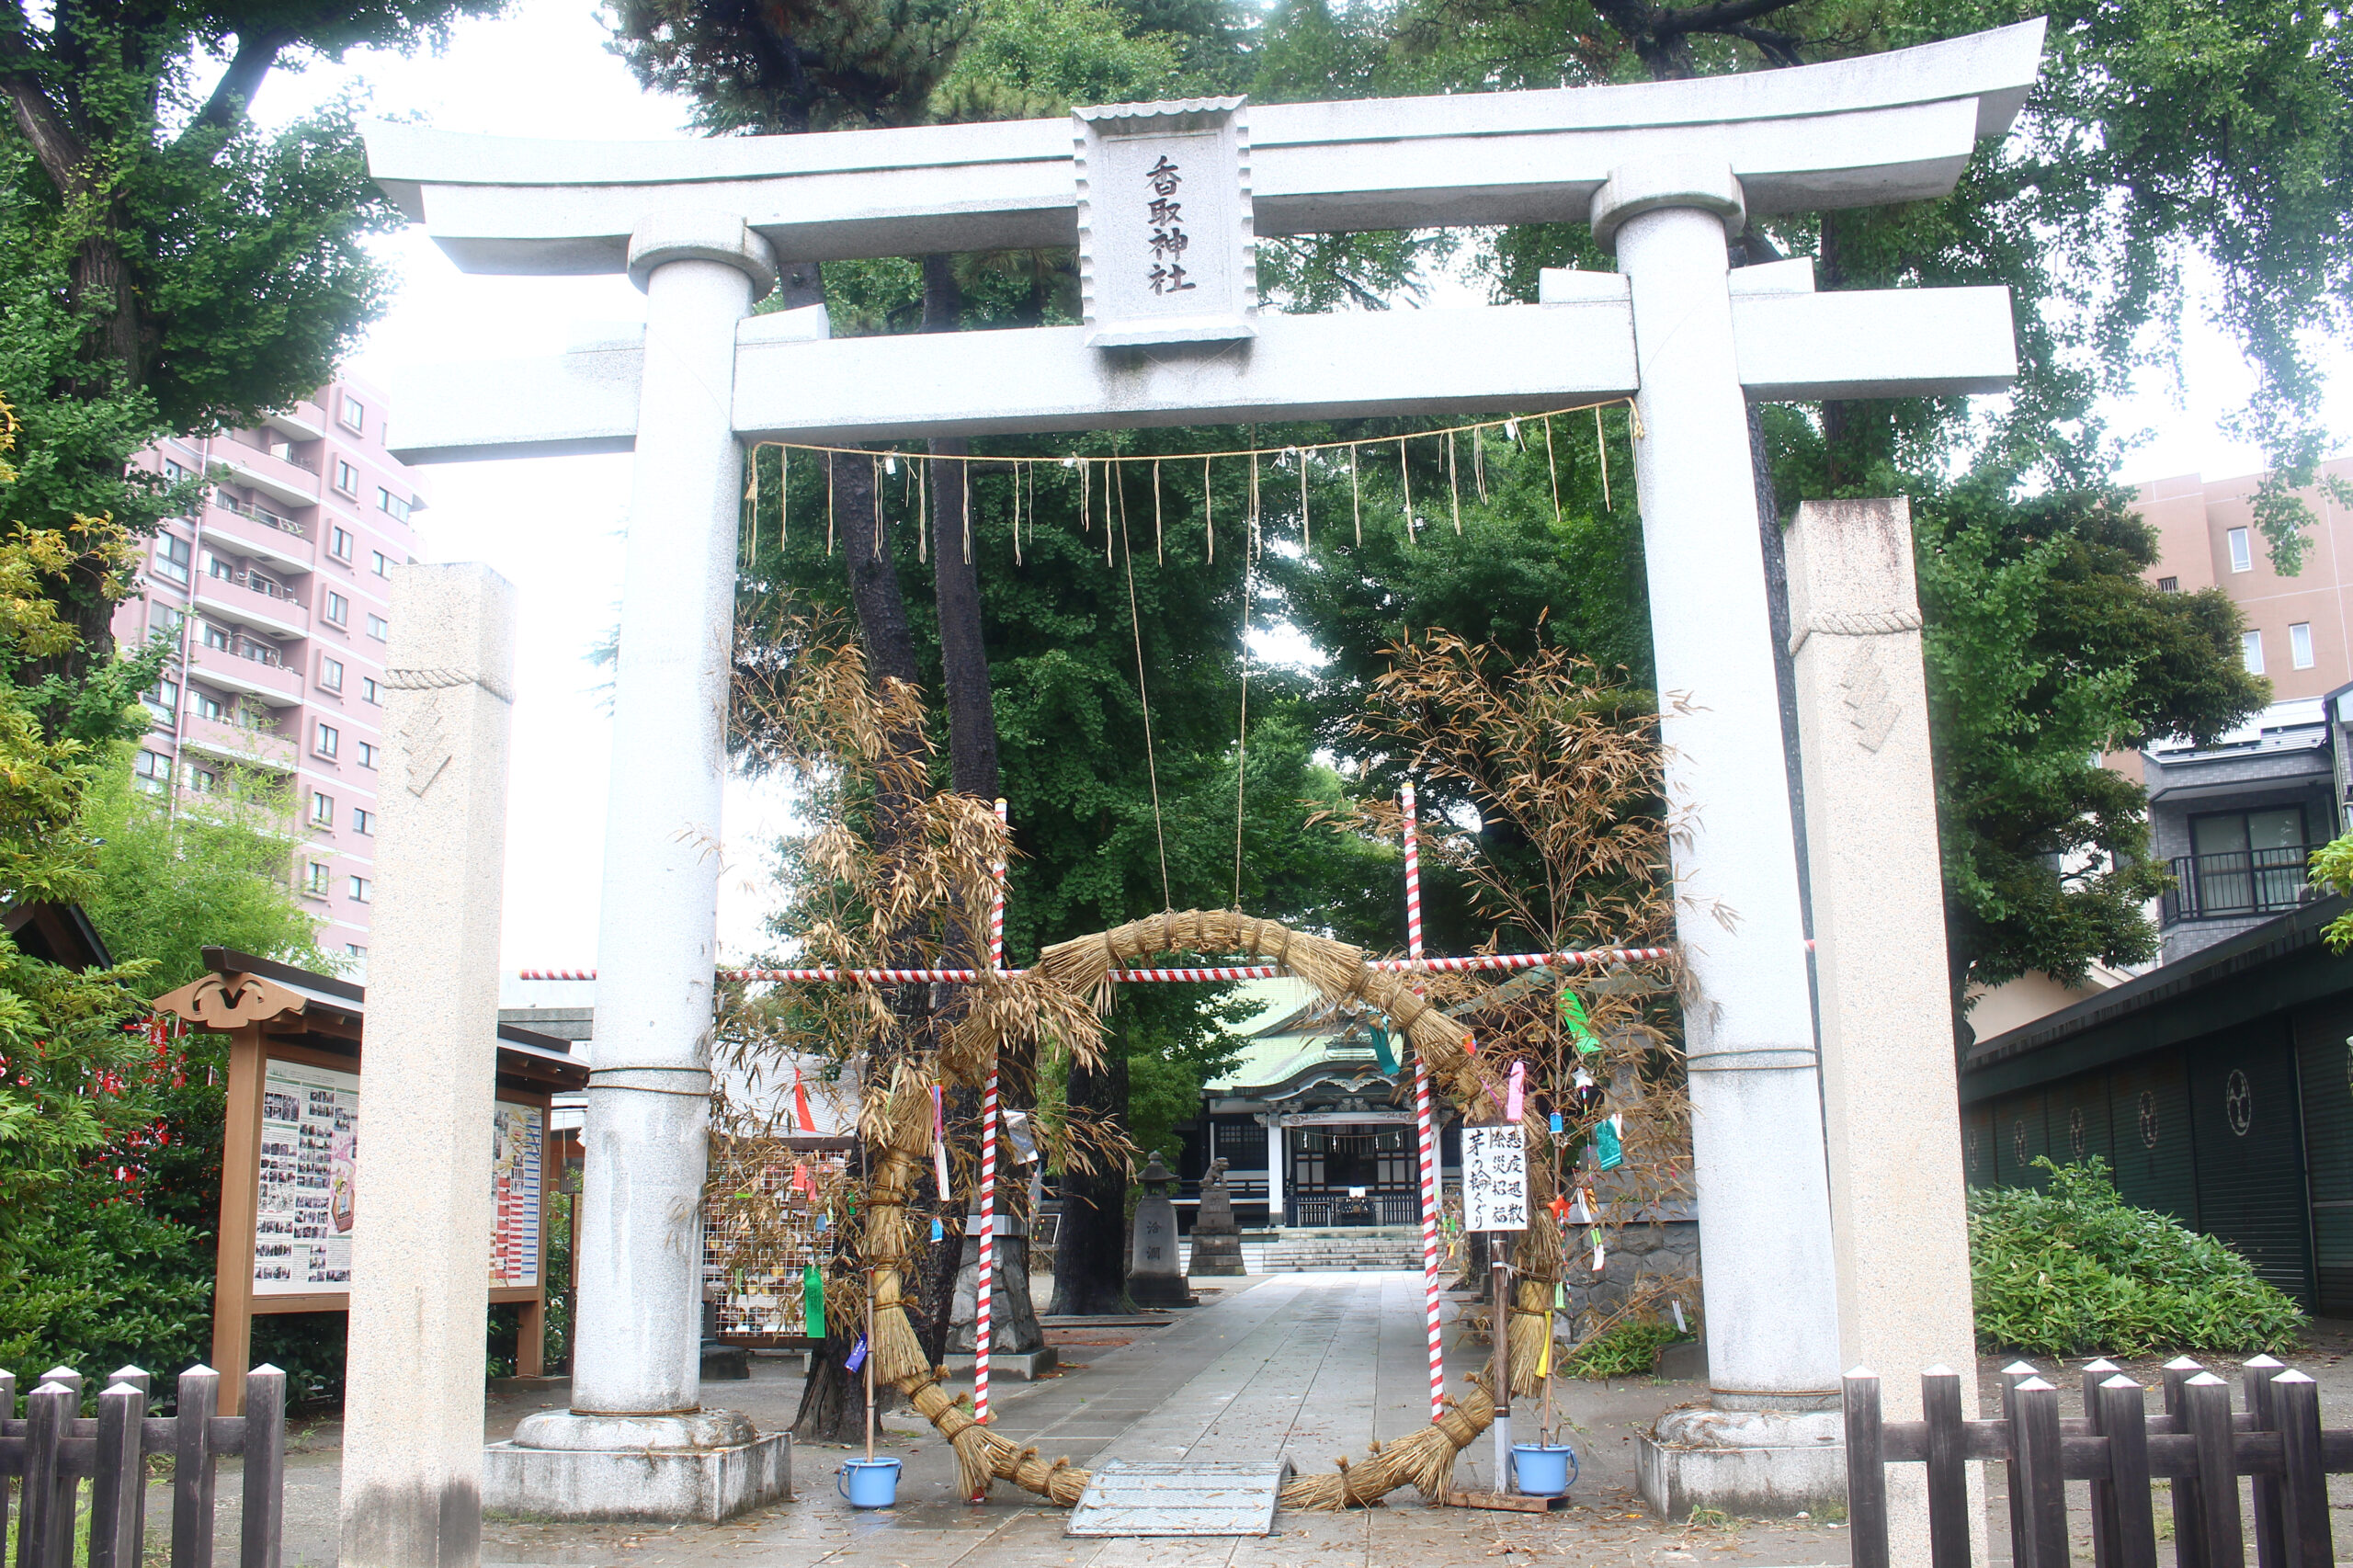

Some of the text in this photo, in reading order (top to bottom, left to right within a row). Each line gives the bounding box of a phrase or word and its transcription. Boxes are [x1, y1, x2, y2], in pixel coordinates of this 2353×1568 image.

[1146, 155, 1196, 296] 香取神社
[1466, 1130, 1491, 1230] 茅の輪くぐり
